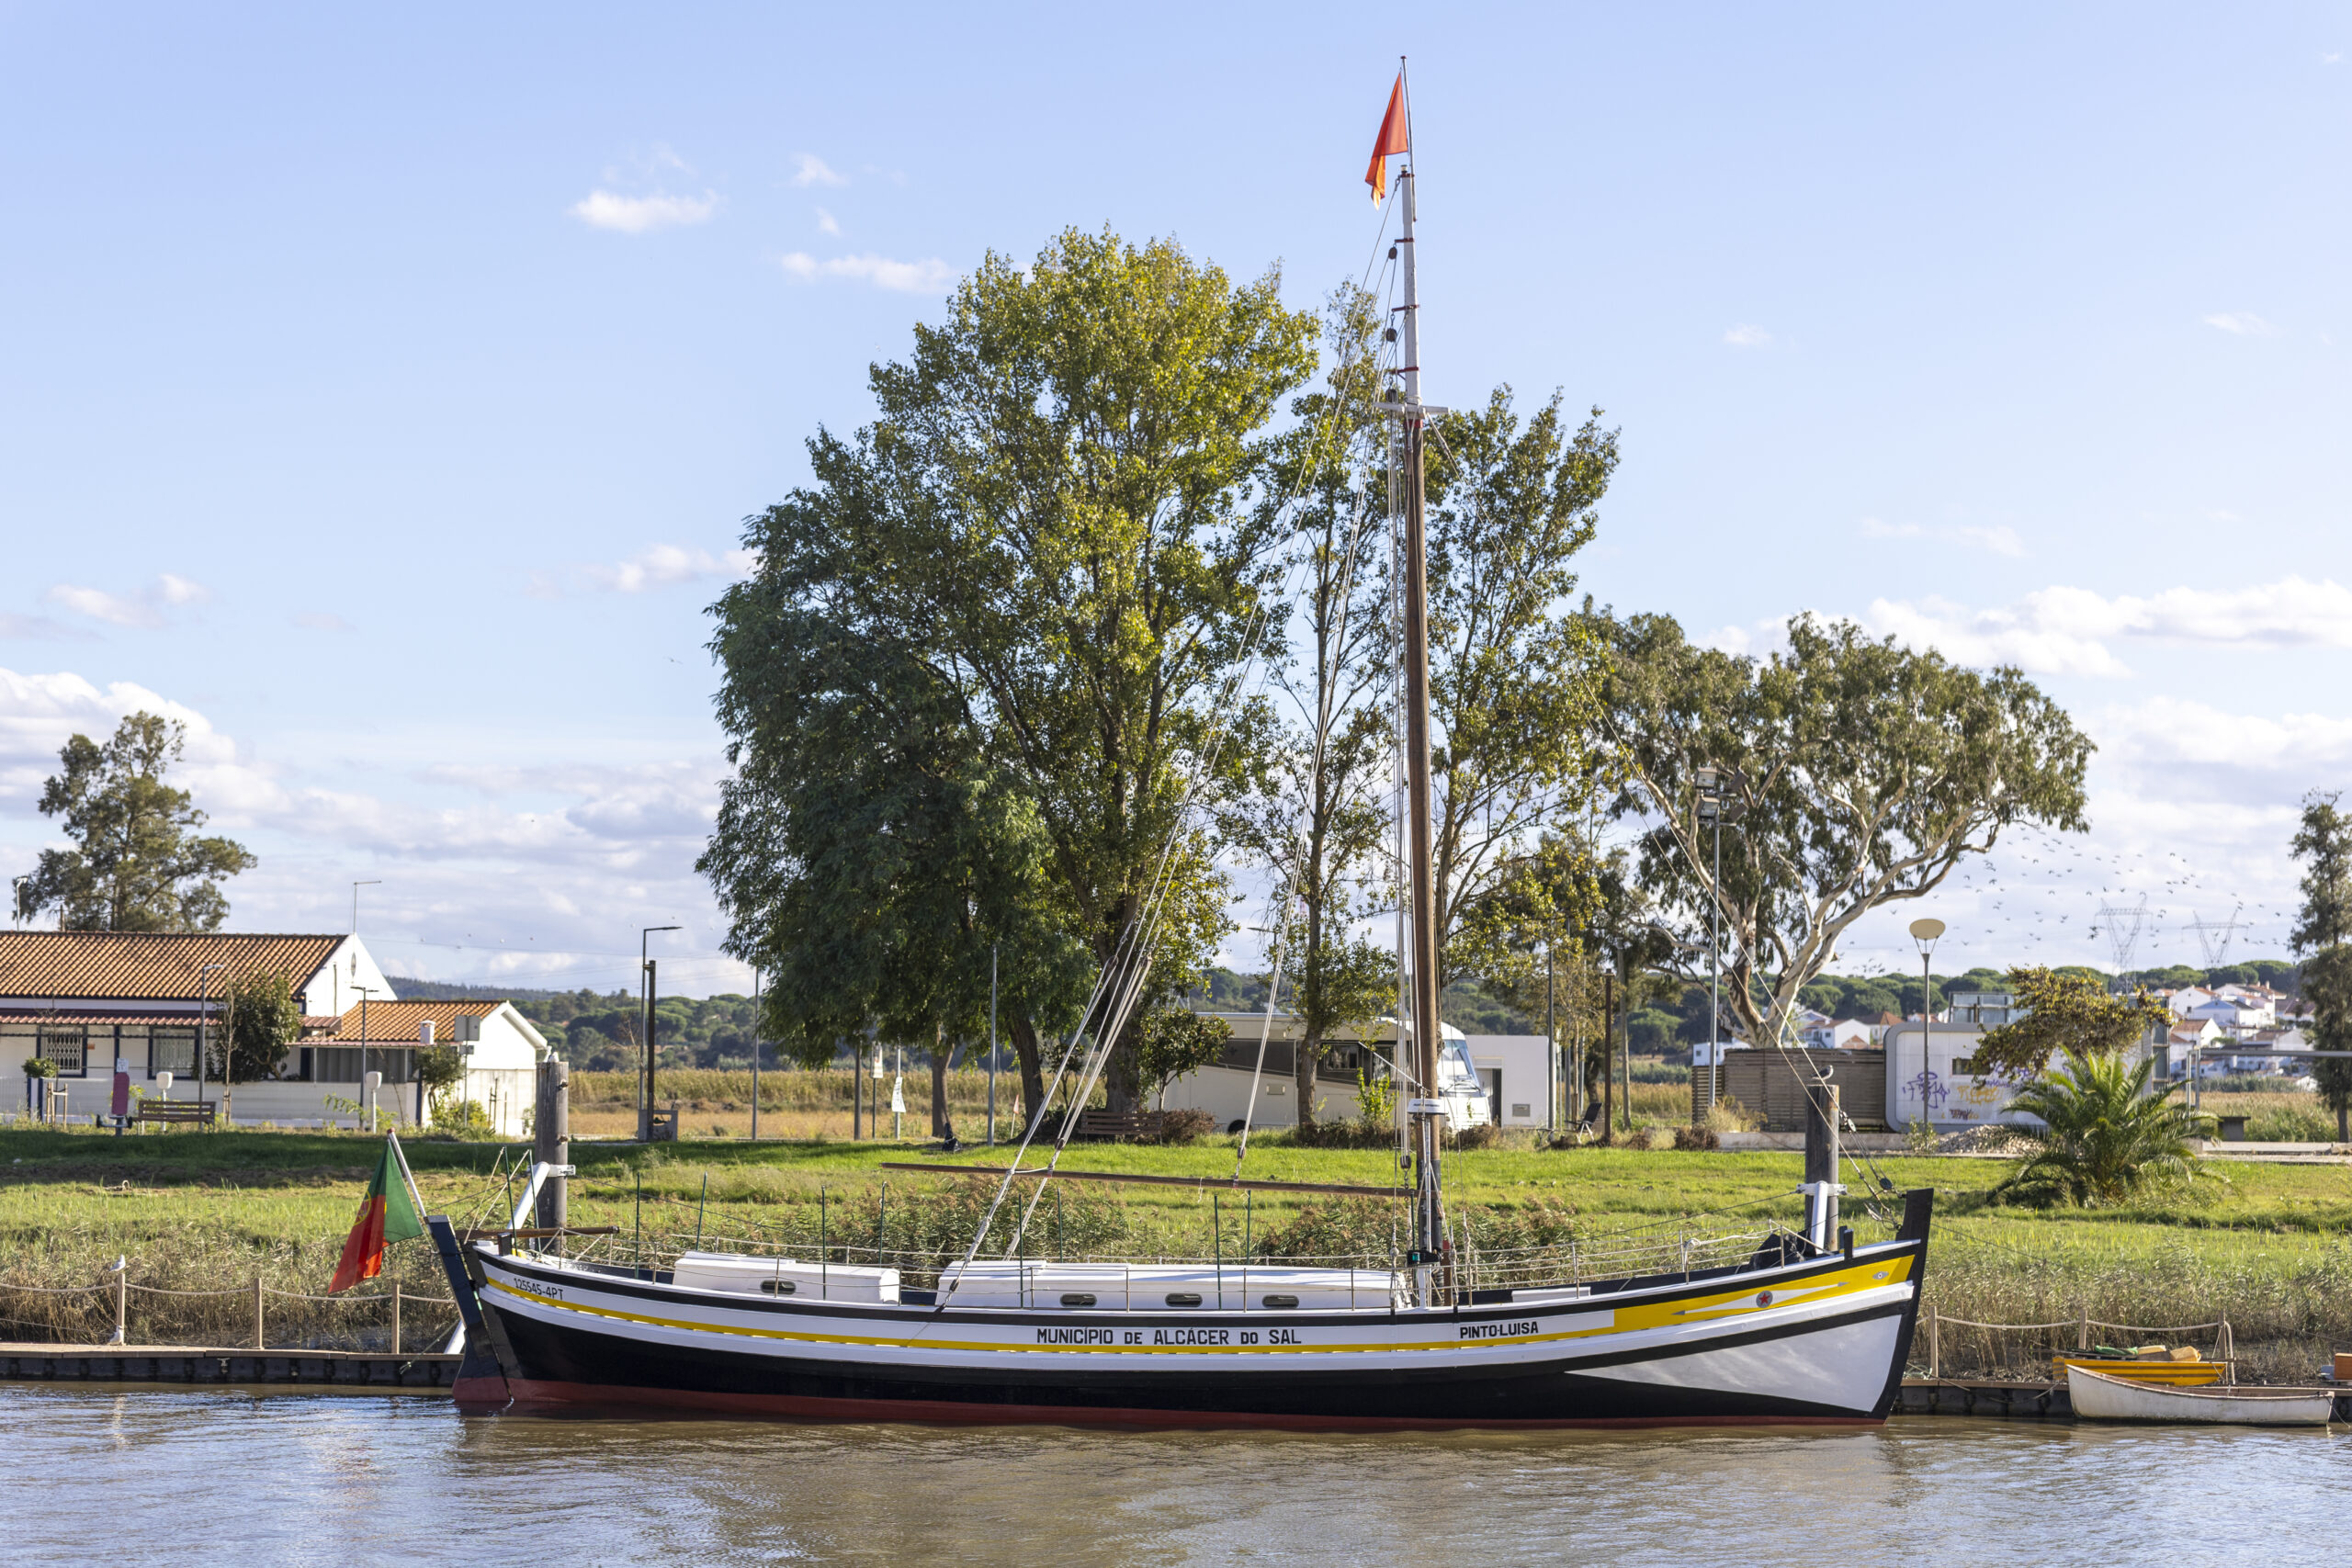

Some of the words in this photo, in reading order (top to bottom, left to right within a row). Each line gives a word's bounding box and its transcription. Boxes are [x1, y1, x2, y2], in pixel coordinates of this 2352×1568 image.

[1036, 1326, 1114, 1345] MUNICÍPIO
[1124, 1331, 1143, 1345] DE
[1153, 1327, 1230, 1346] ALCÁCER
[1240, 1331, 1259, 1345] DO
[1269, 1328, 1302, 1345] SAL
